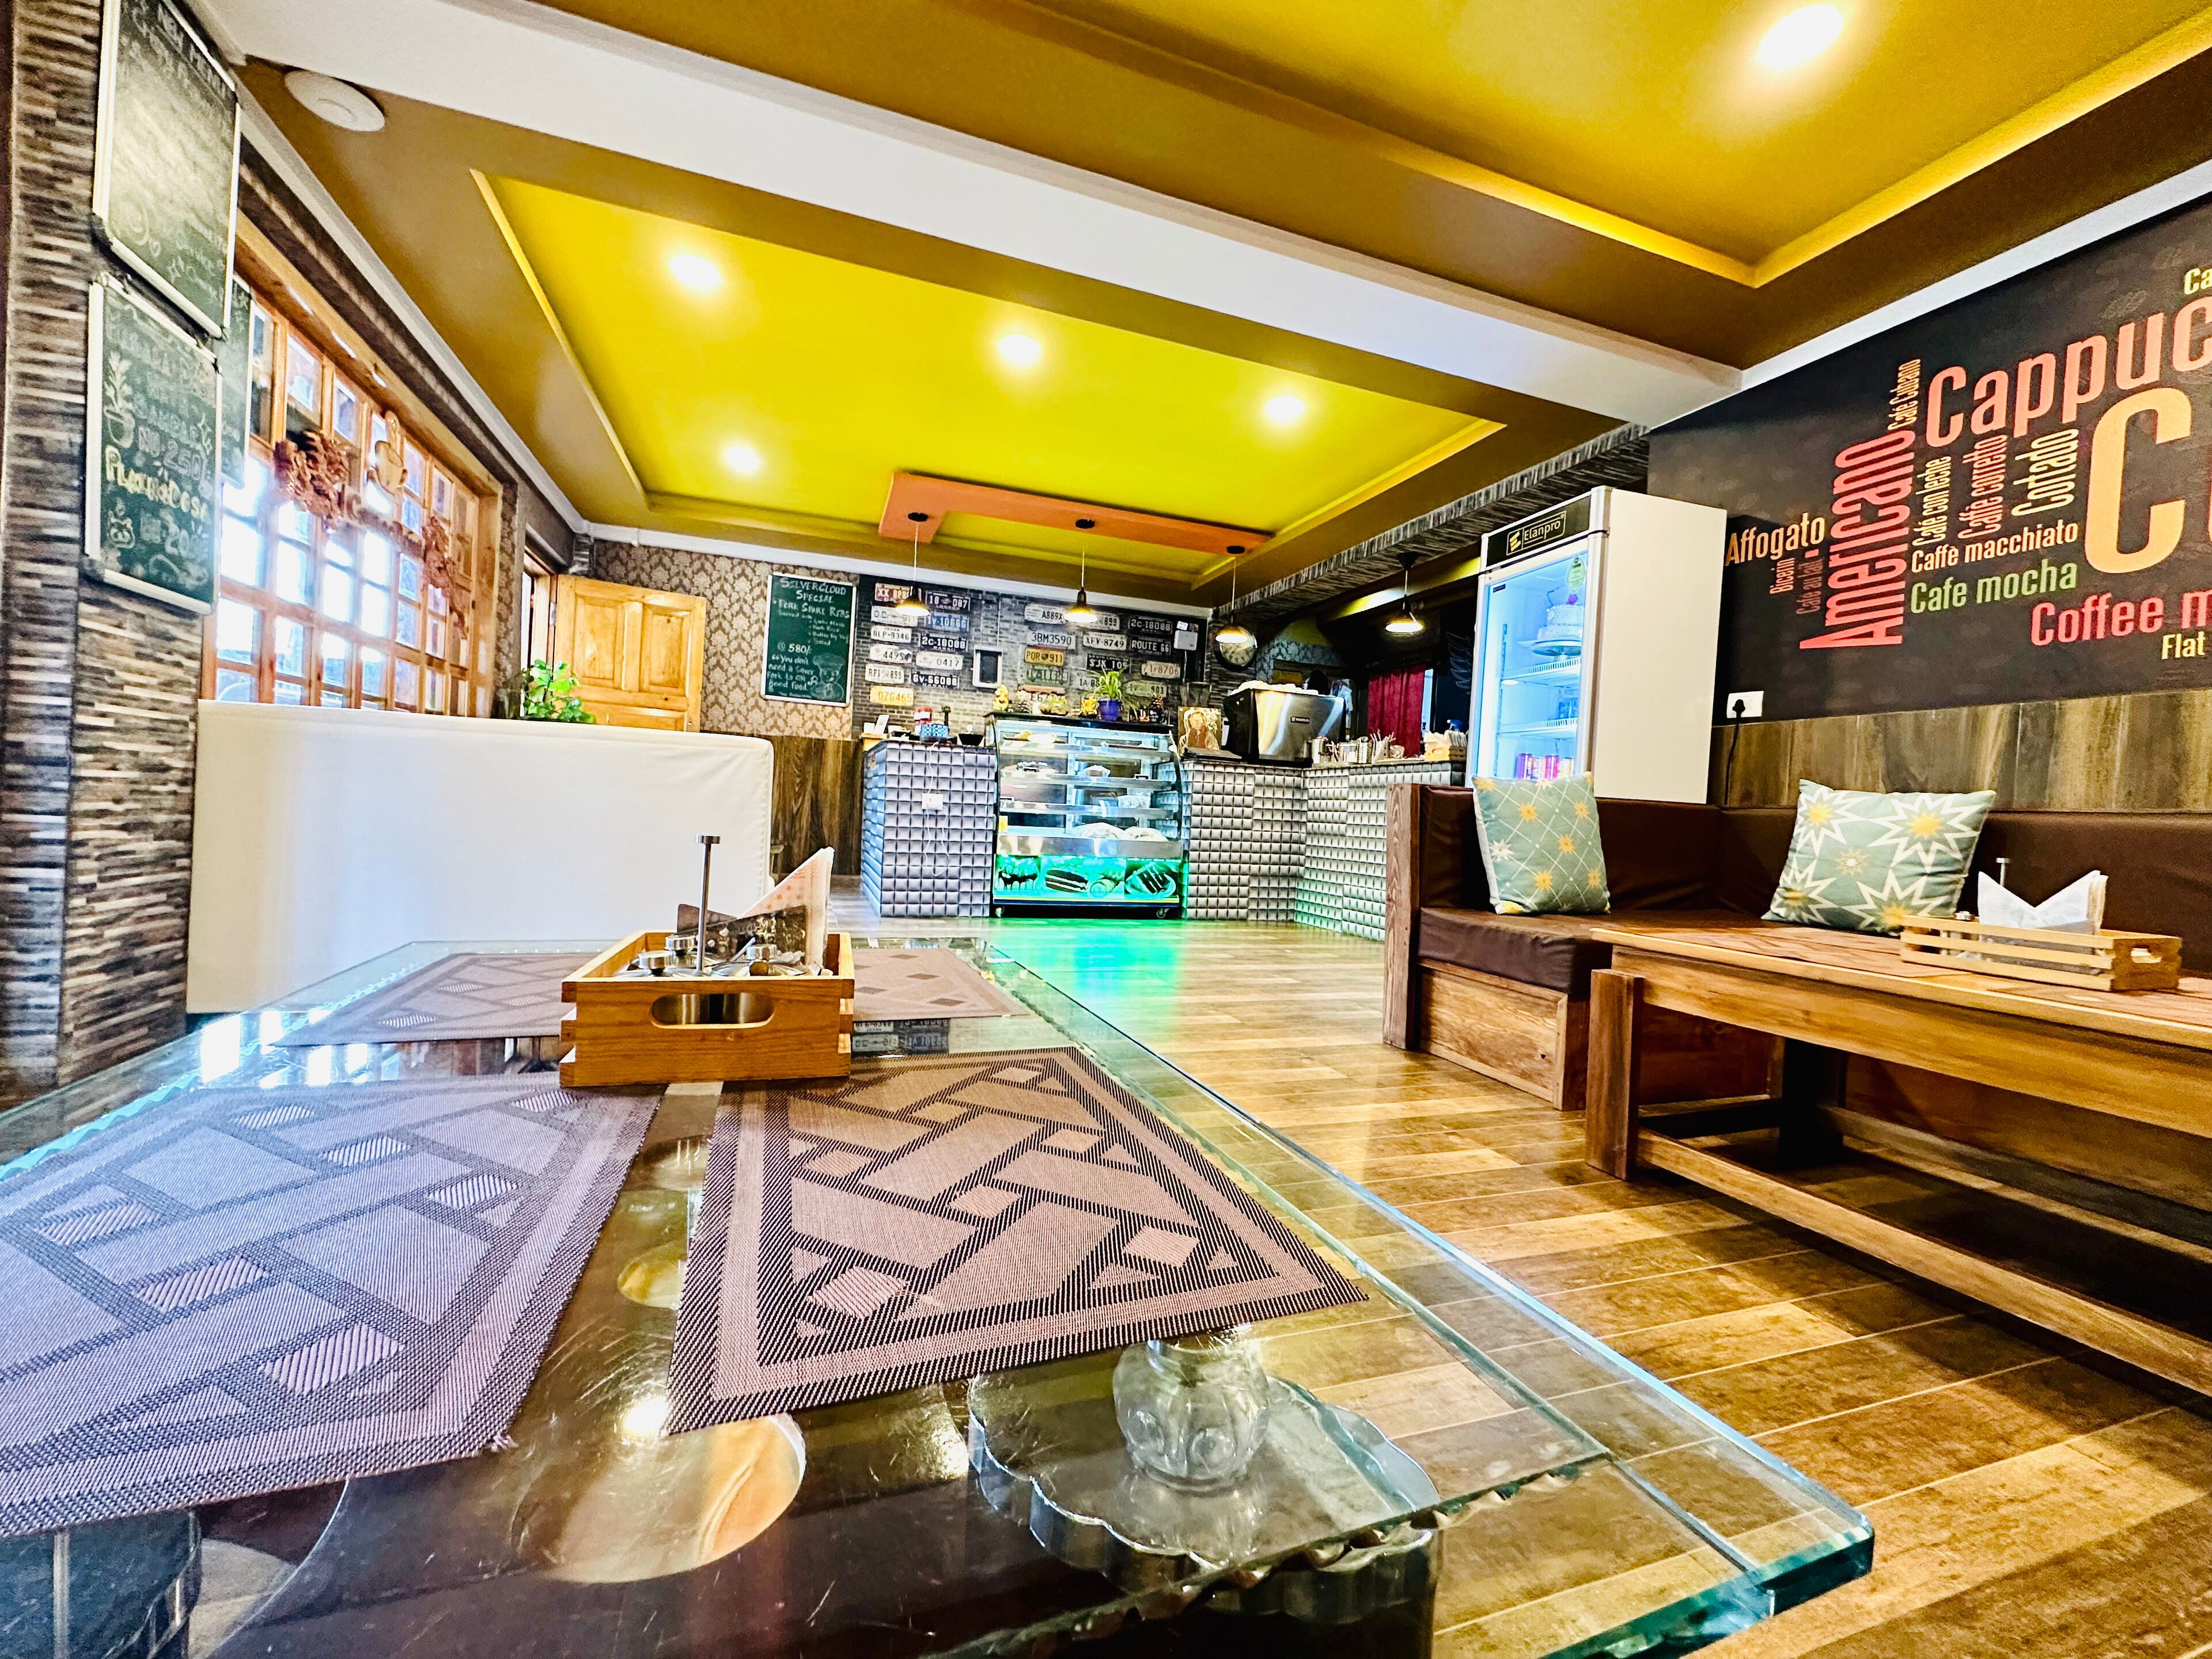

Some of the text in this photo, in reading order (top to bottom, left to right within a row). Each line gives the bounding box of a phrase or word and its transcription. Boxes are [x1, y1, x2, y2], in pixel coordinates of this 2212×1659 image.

[1889, 358, 1921, 405] Cubano
[1915, 456, 1952, 495] leche
[1962, 434, 2008, 497] corretto
[2011, 429, 2080, 516] Cortado
[1922, 490, 1949, 516] con
[1524, 520, 1561, 540] Elanpro
[1725, 512, 1825, 566] Affogato
[1800, 429, 1916, 649] Americano
[1964, 519, 2079, 563] macchiato
[1769, 557, 1795, 594] Bicerin
[1803, 576, 1822, 590] au
[1910, 559, 2078, 614] Cafe mocha
[796, 589, 835, 603] SPECIAL
[830, 606, 850, 619] RIBS
[2031, 592, 2165, 646] Coffee
[1031, 632, 1071, 646] 3BM3590
[1131, 640, 1157, 651] ROUTE
[1161, 643, 1169, 653] 66
[2161, 631, 2206, 660] Flat
[768, 663, 786, 671] need
[937, 658, 959, 666] 0417
[1050, 654, 1063, 663] 911
[1089, 658, 1107, 668] SJK
